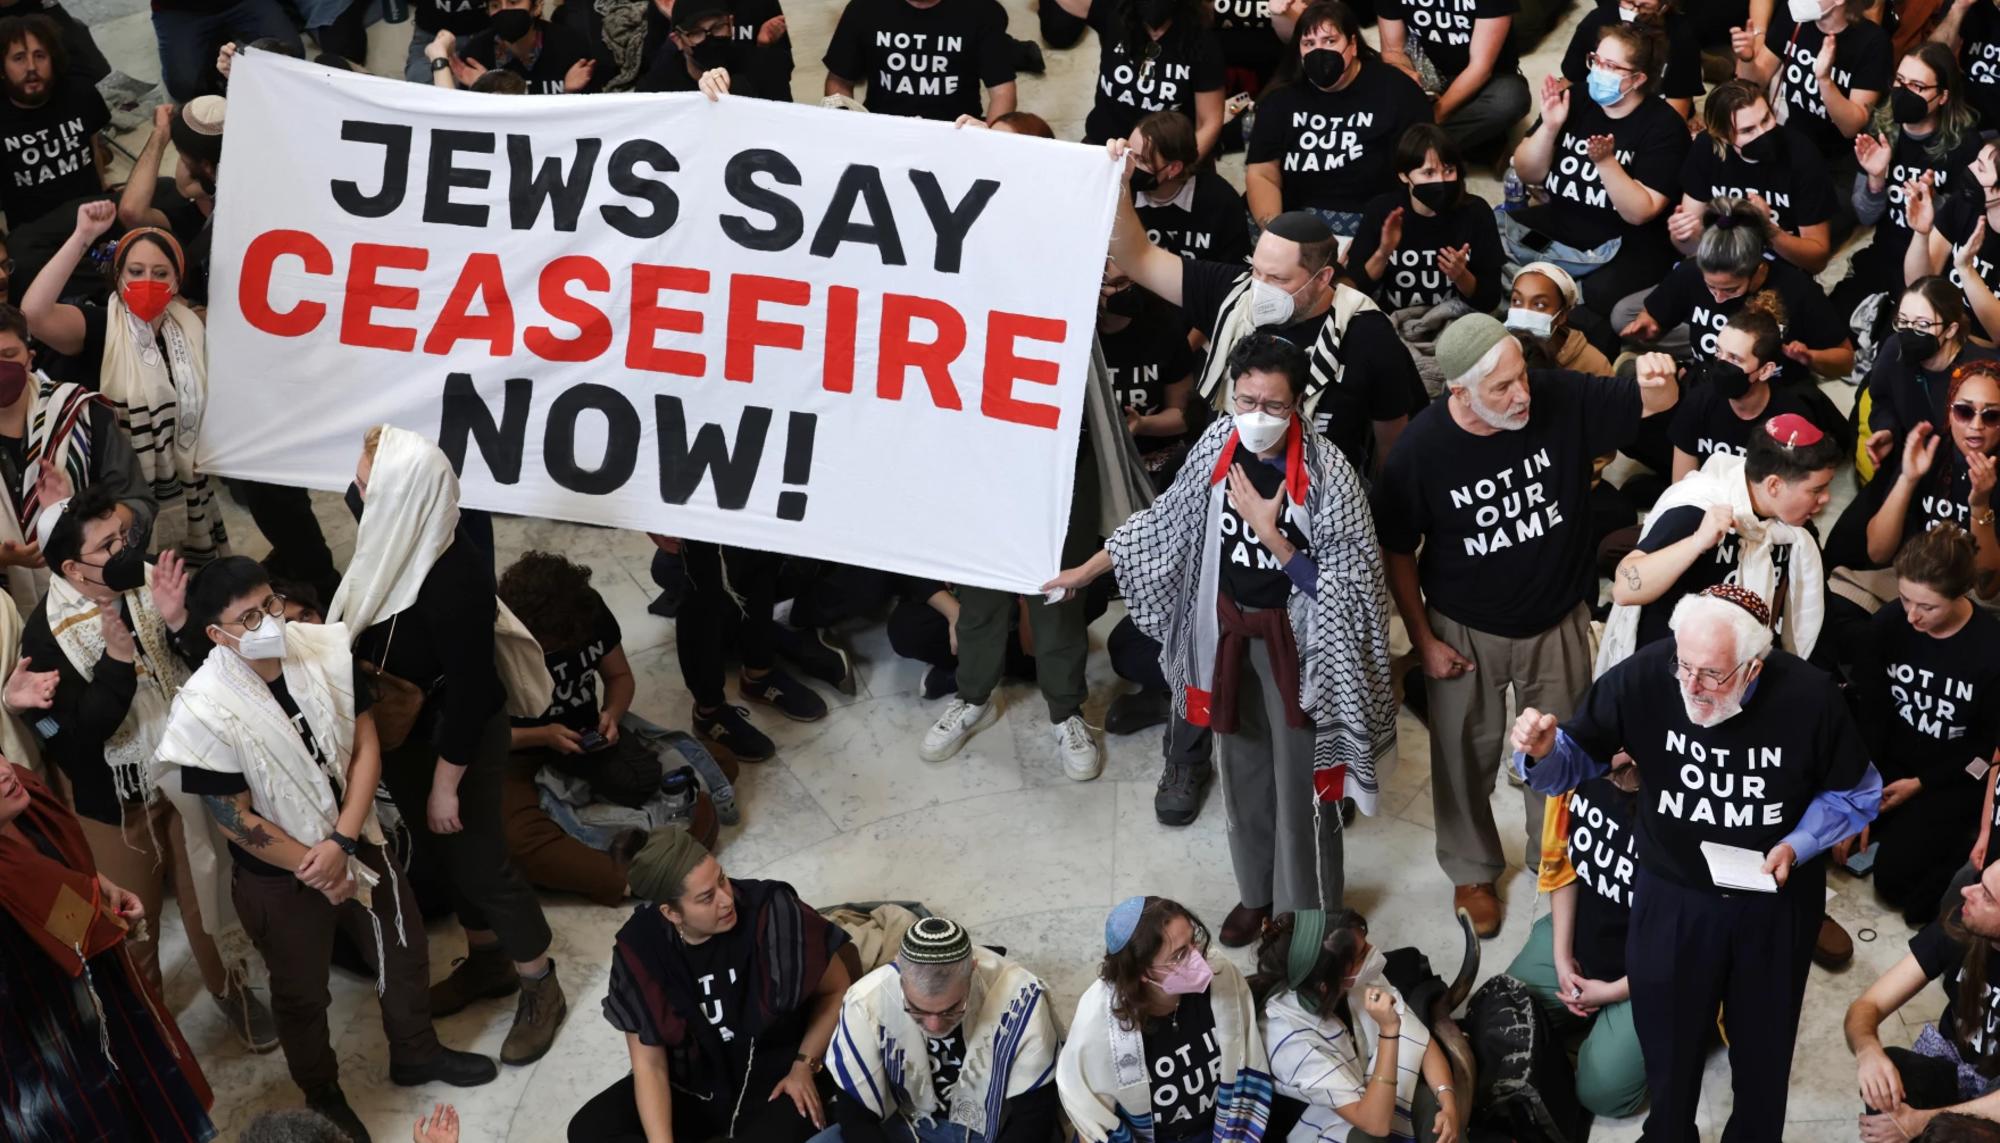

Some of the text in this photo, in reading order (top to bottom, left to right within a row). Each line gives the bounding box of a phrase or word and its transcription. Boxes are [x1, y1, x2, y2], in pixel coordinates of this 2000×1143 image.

[1413, 10, 1471, 29] OUR
[876, 30, 962, 52] NOT IN
[886, 52, 948, 73] OUR
[1165, 63, 1191, 80] IN
[880, 70, 959, 96] NAME
[1113, 64, 1177, 101] OUR
[1787, 64, 1819, 95] OU
[4, 117, 84, 152] NOT IN
[1292, 111, 1374, 131] NOT IN
[1299, 130, 1358, 151] OUR
[1562, 132, 1590, 155] NO
[13, 146, 92, 187] NAME
[1284, 144, 1364, 172] NAME
[1560, 156, 1600, 182] OU
[1885, 163, 1921, 183] OT
[331, 119, 1000, 273] JEWS SAY
[1546, 170, 1609, 209] NAM
[1765, 190, 1790, 208] IN
[1185, 230, 1211, 249] IN
[1395, 270, 1455, 289] OU
[239, 229, 1068, 430] CEASEFIRE
[1692, 306, 1728, 331] NO
[1133, 363, 1159, 384] IN
[440, 372, 816, 522] NOW!
[1449, 448, 1551, 509] NOT IN
[1476, 482, 1546, 528] OUR
[1463, 500, 1564, 556] NAME
[1221, 537, 1283, 570] AM
[580, 639, 604, 668] IN
[1891, 684, 1956, 721] OUR
[1944, 677, 1974, 702] IN
[1895, 701, 1968, 740] AME
[1665, 729, 1782, 770] NOT IN
[1680, 763, 1766, 799] OUR
[1569, 793, 1620, 840] NOT
[1657, 789, 1783, 828] NAME
[1573, 826, 1634, 885] OUR
[1155, 1043, 1192, 1078] OT
